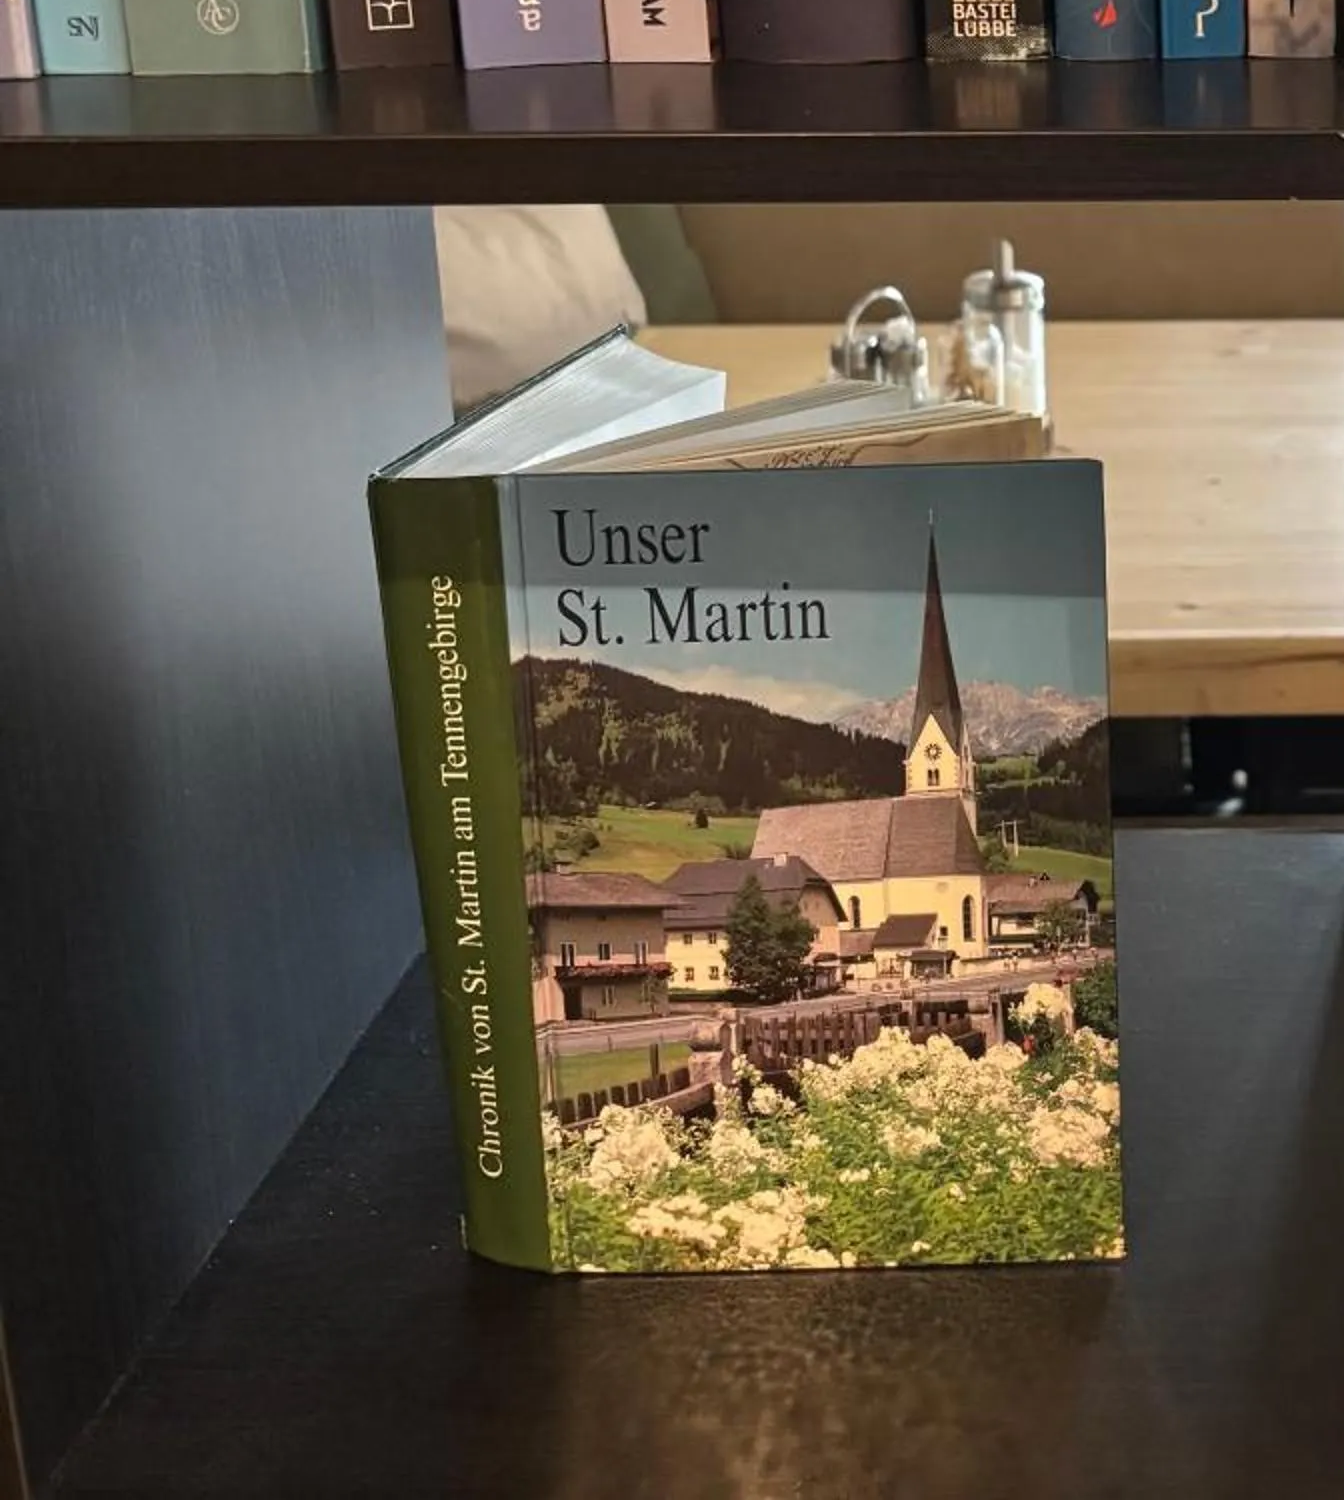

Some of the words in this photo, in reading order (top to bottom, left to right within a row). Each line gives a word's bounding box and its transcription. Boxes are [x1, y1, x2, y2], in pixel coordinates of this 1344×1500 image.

[953, 3, 1017, 19] BASTEI
[552, 508, 710, 568] Unser
[557, 588, 624, 647] St.
[644, 581, 831, 646] Martin
[427, 575, 469, 788] Tennengebirge
[452, 797, 475, 842] am
[450, 850, 484, 948] Martin
[462, 959, 487, 995] St.
[471, 1005, 489, 1049] von
[471, 1064, 500, 1179] Chronik
